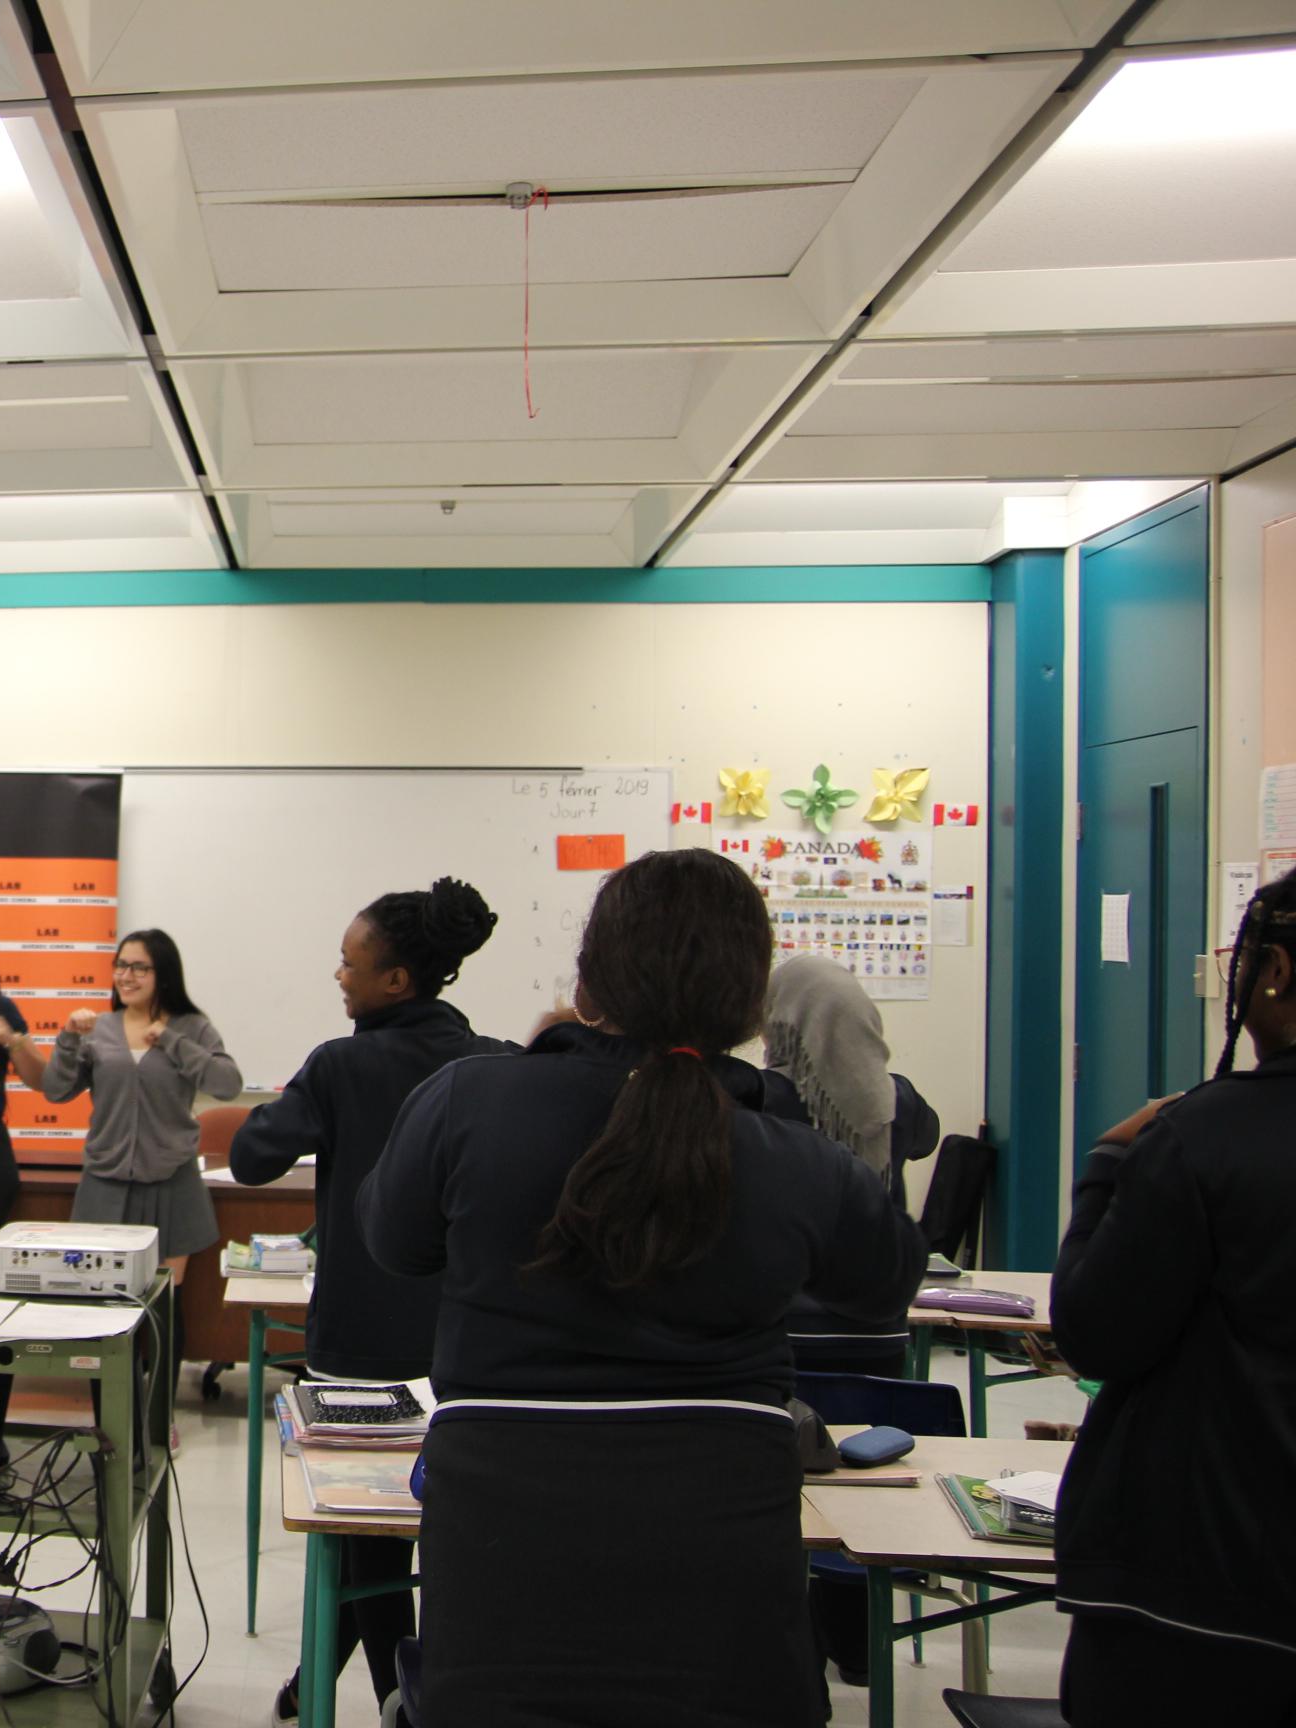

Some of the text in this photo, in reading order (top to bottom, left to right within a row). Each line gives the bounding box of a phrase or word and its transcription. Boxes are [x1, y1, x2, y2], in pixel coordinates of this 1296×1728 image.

[511, 775, 649, 798] Le 5 février 2019
[0, 882, 21, 890] LAB
[74, 883, 95, 891] LAB
[37, 928, 59, 937] LAB
[72, 975, 94, 984] LAB
[36, 1022, 58, 1030] LAB
[35, 1115, 57, 1123] LAB
